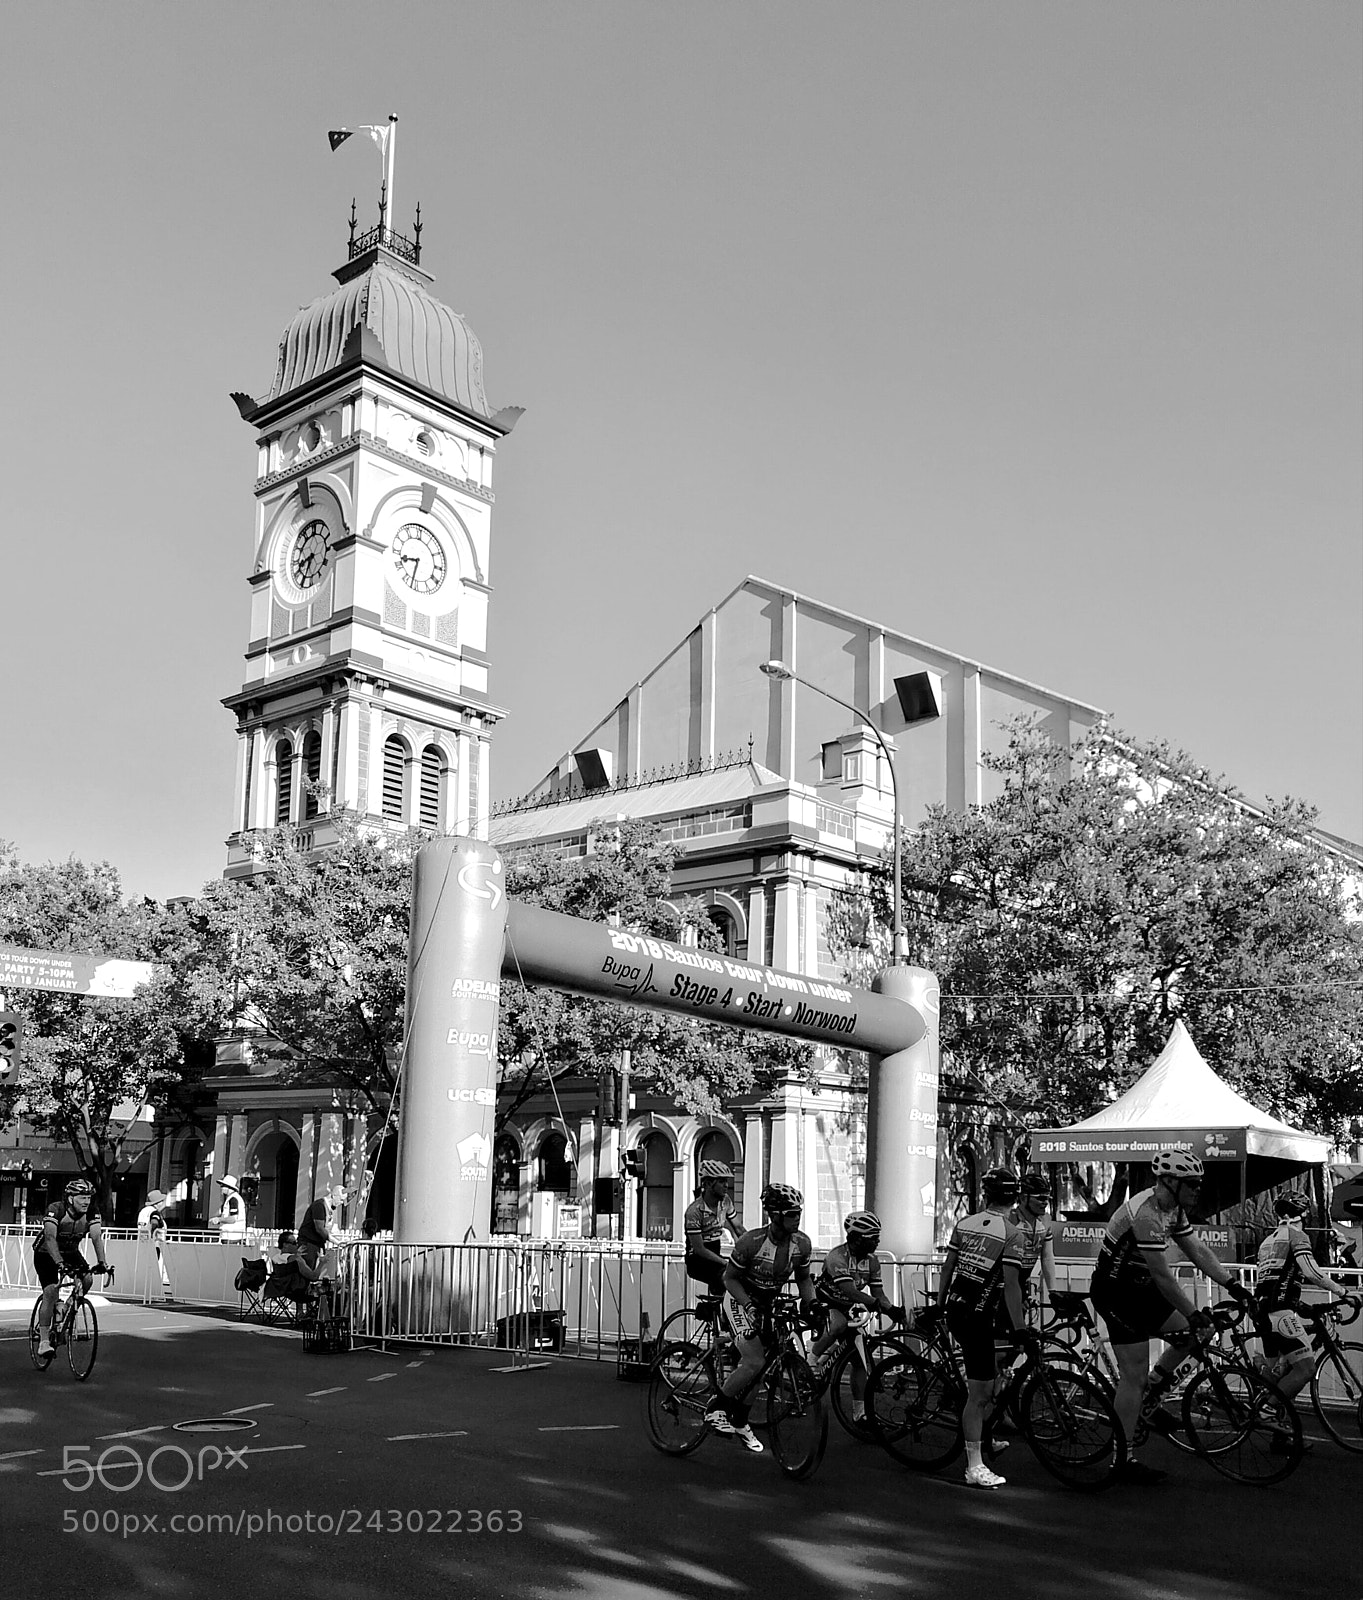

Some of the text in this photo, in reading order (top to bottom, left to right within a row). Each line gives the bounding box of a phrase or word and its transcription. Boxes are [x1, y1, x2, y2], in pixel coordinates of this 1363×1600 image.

[11, 955, 29, 963] TOUR
[30, 957, 50, 965] DOWN
[51, 959, 72, 968] UNDER
[601, 956, 641, 980] Bupa
[608, 929, 853, 1003] 2018 Santos tour down under
[5, 963, 74, 979] PARTY 5-10PM
[21, 976, 32, 985] 18
[34, 977, 78, 989] JANUARY
[452, 991, 477, 999] SOUTH
[670, 973, 857, 1034] Stage 4 Start Norwood
[446, 1028, 488, 1048] Bupa
[1039, 1141, 1194, 1152] 2018 Santos tour down under
